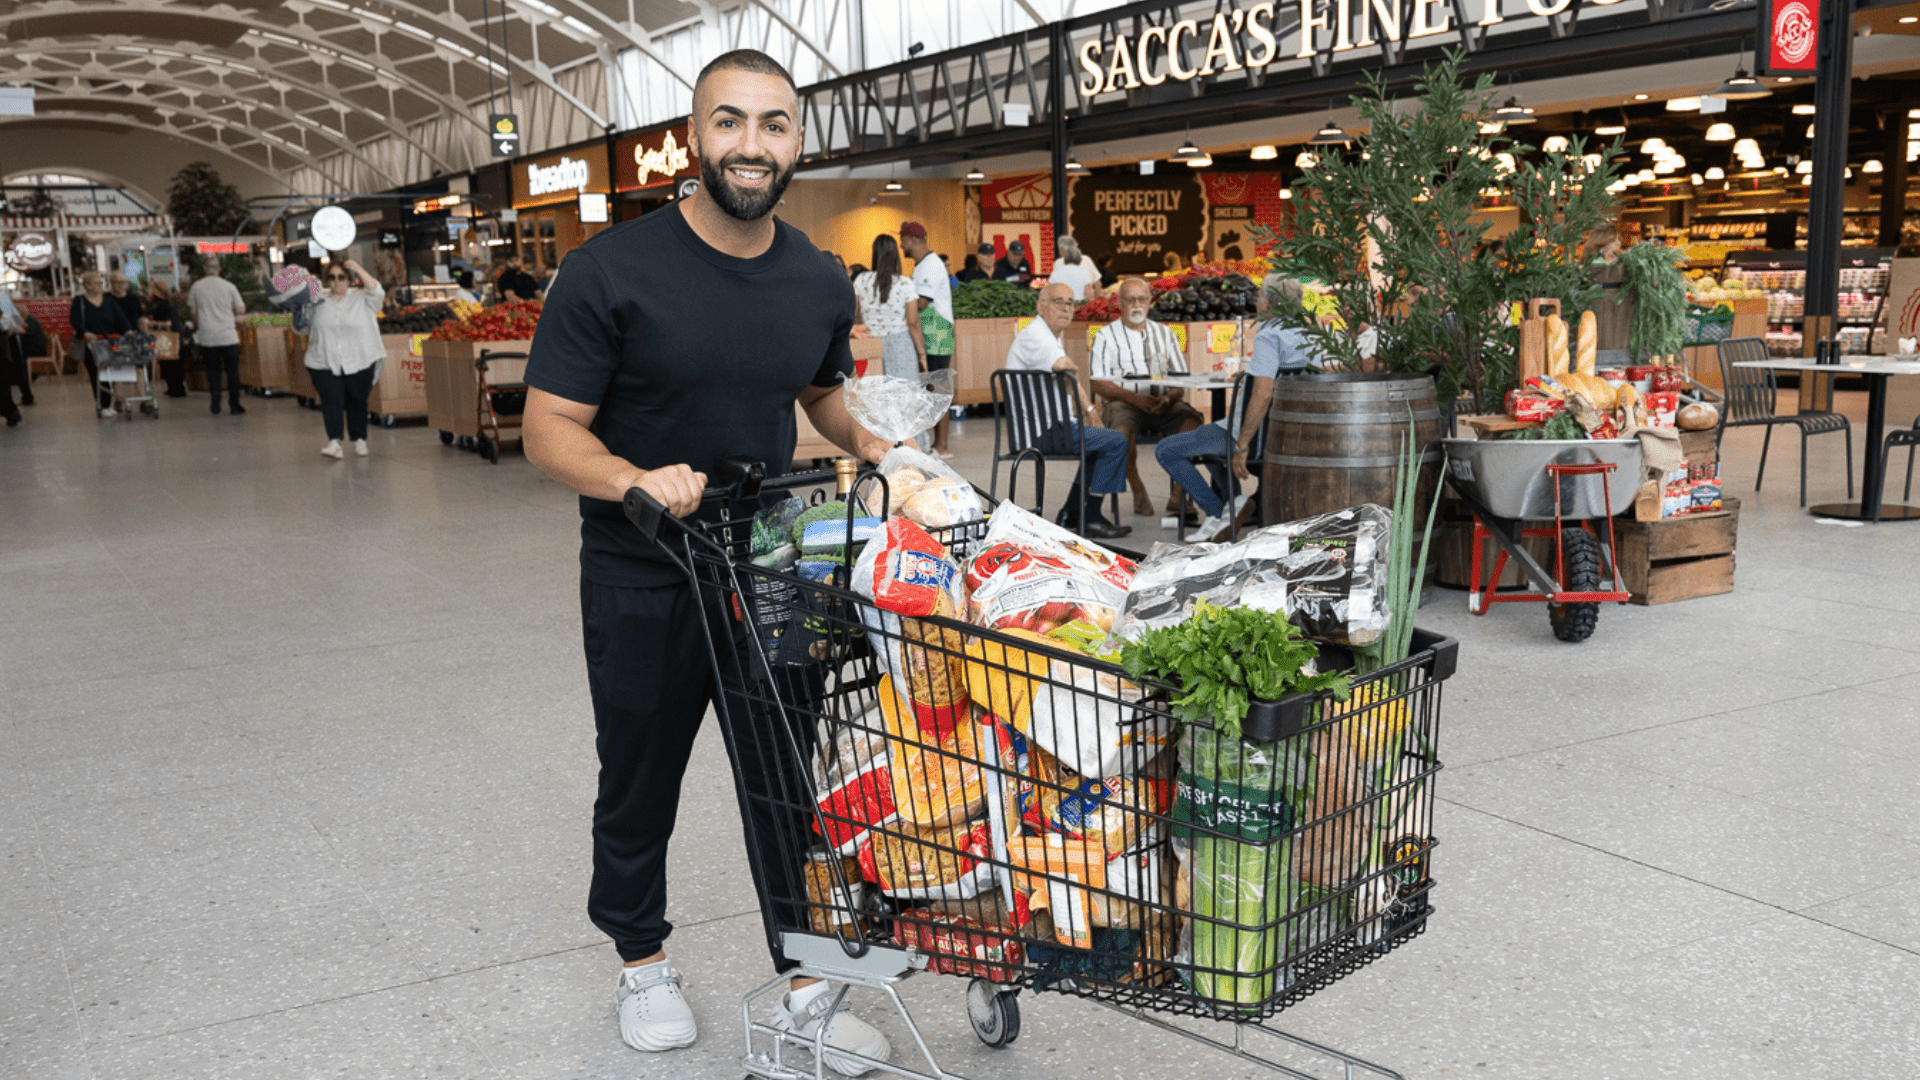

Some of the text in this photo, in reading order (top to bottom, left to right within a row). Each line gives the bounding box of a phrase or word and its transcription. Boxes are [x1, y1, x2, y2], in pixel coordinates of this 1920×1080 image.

[1080, 0, 1451, 97] SACCA'S FINE
[1094, 189, 1182, 212] PERFECTLY
[1001, 210, 1029, 221] MARKET
[1110, 213, 1167, 237] PICKED
[409, 372, 426, 382] PIC
[1178, 781, 1214, 806] RESH
[1199, 808, 1248, 828] LASS
